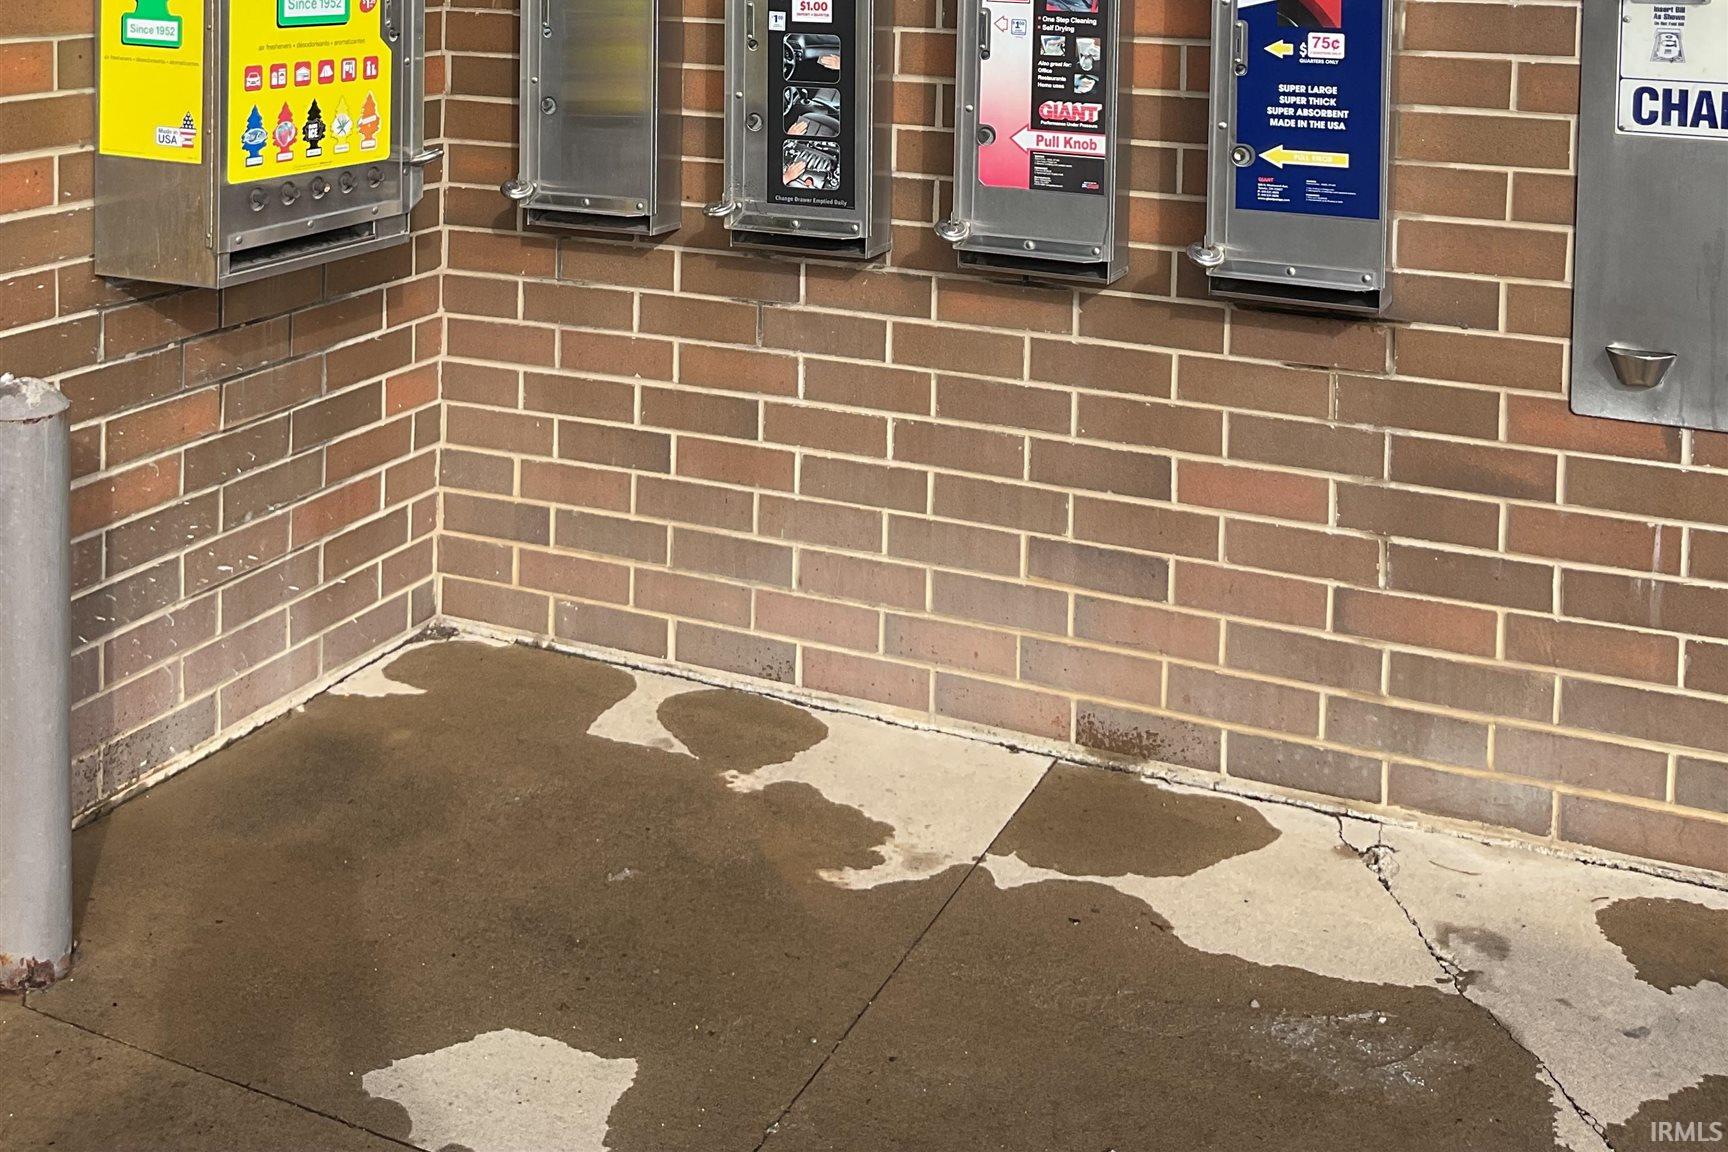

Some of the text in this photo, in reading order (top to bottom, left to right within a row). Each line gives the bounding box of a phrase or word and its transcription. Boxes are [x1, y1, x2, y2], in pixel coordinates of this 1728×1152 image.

[800, 0, 828, 11] $1.00
[1653, 5, 1674, 13] Insert
[1056, 16, 1070, 24] Step
[1070, 17, 1097, 26] Cleaning
[1663, 13, 1686, 21] Shown
[130, 23, 176, 36] Since 1952
[1055, 25, 1075, 33] Drying
[1312, 36, 1340, 50] 75¢
[1278, 84, 1338, 95] SUPER LARGE
[1279, 95, 1337, 107] SUPER THICK
[1038, 100, 1103, 123] GIANT
[1266, 106, 1349, 119] SUPER ABSORBENT
[1269, 118, 1346, 130] MADE IN THE USA
[158, 134, 178, 145] USA
[1035, 134, 1098, 151] Pull Knob
[775, 194, 794, 202] Change
[813, 197, 834, 205] Emptied
[834, 199, 848, 207] Daily
